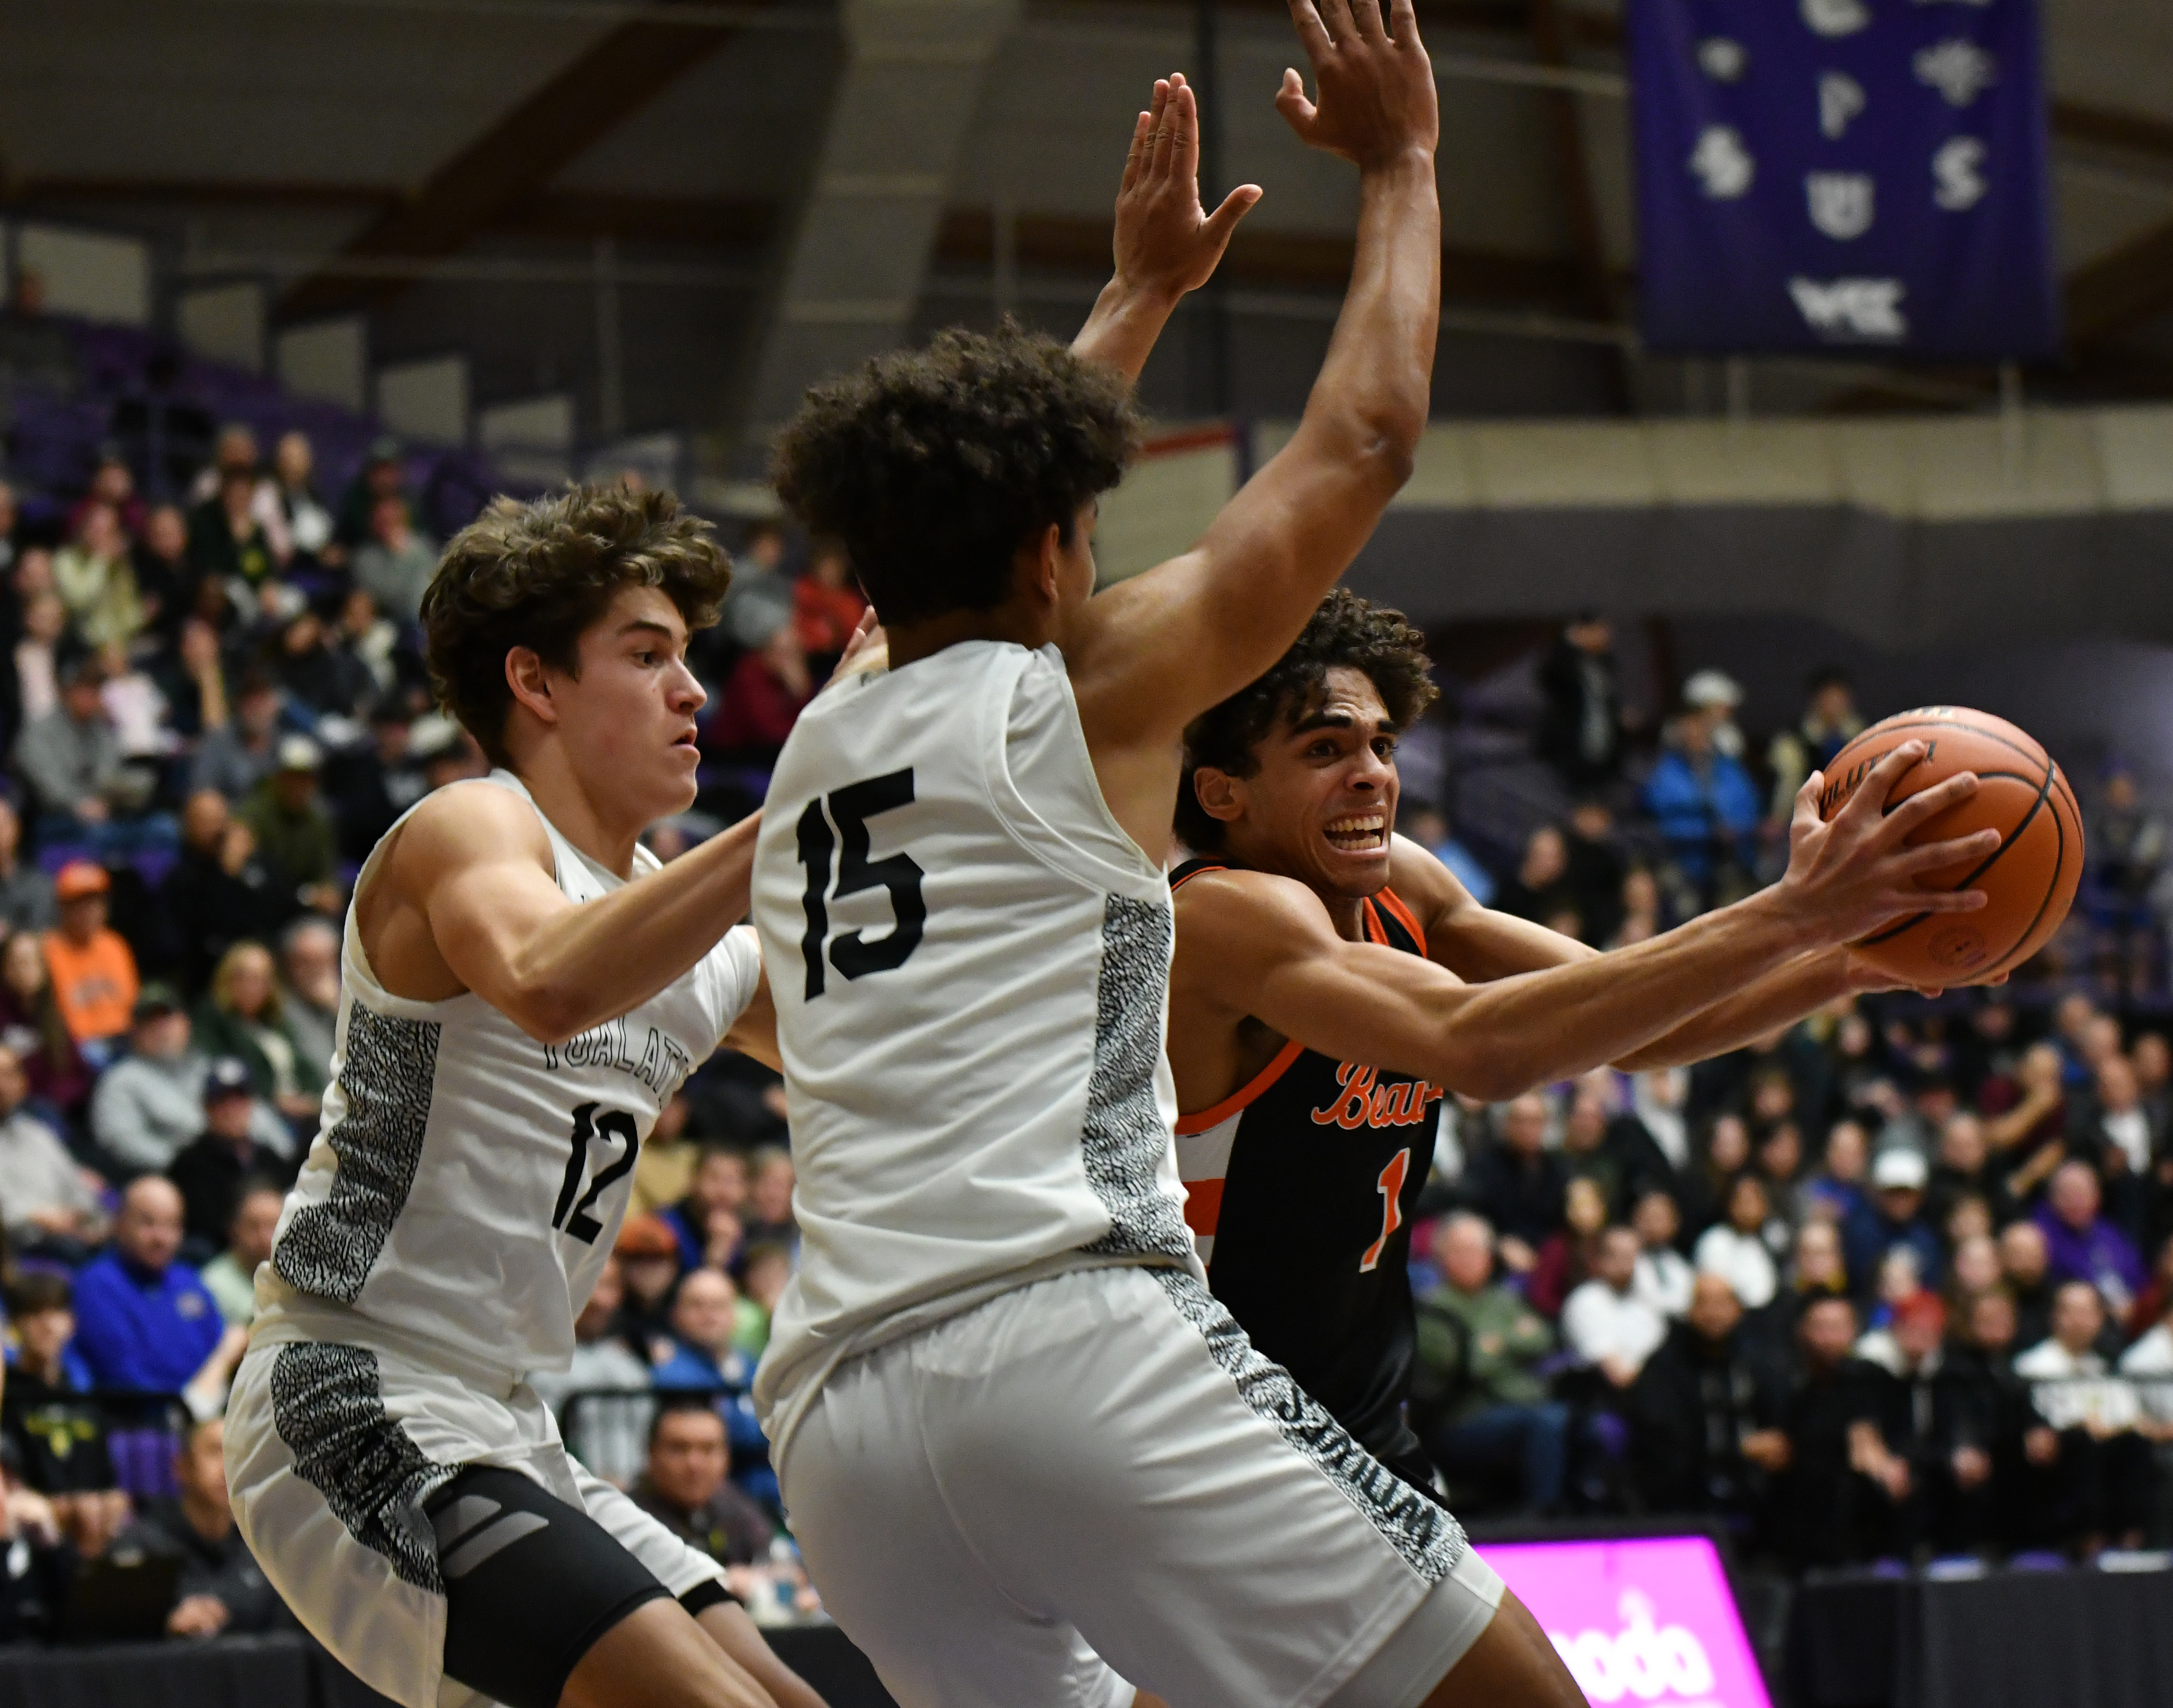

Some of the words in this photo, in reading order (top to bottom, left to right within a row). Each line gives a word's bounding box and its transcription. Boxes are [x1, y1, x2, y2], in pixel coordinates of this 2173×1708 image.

[797, 766, 926, 1003] 15
[552, 1101, 639, 1245] 12
[1359, 1147, 1410, 1273] 1
